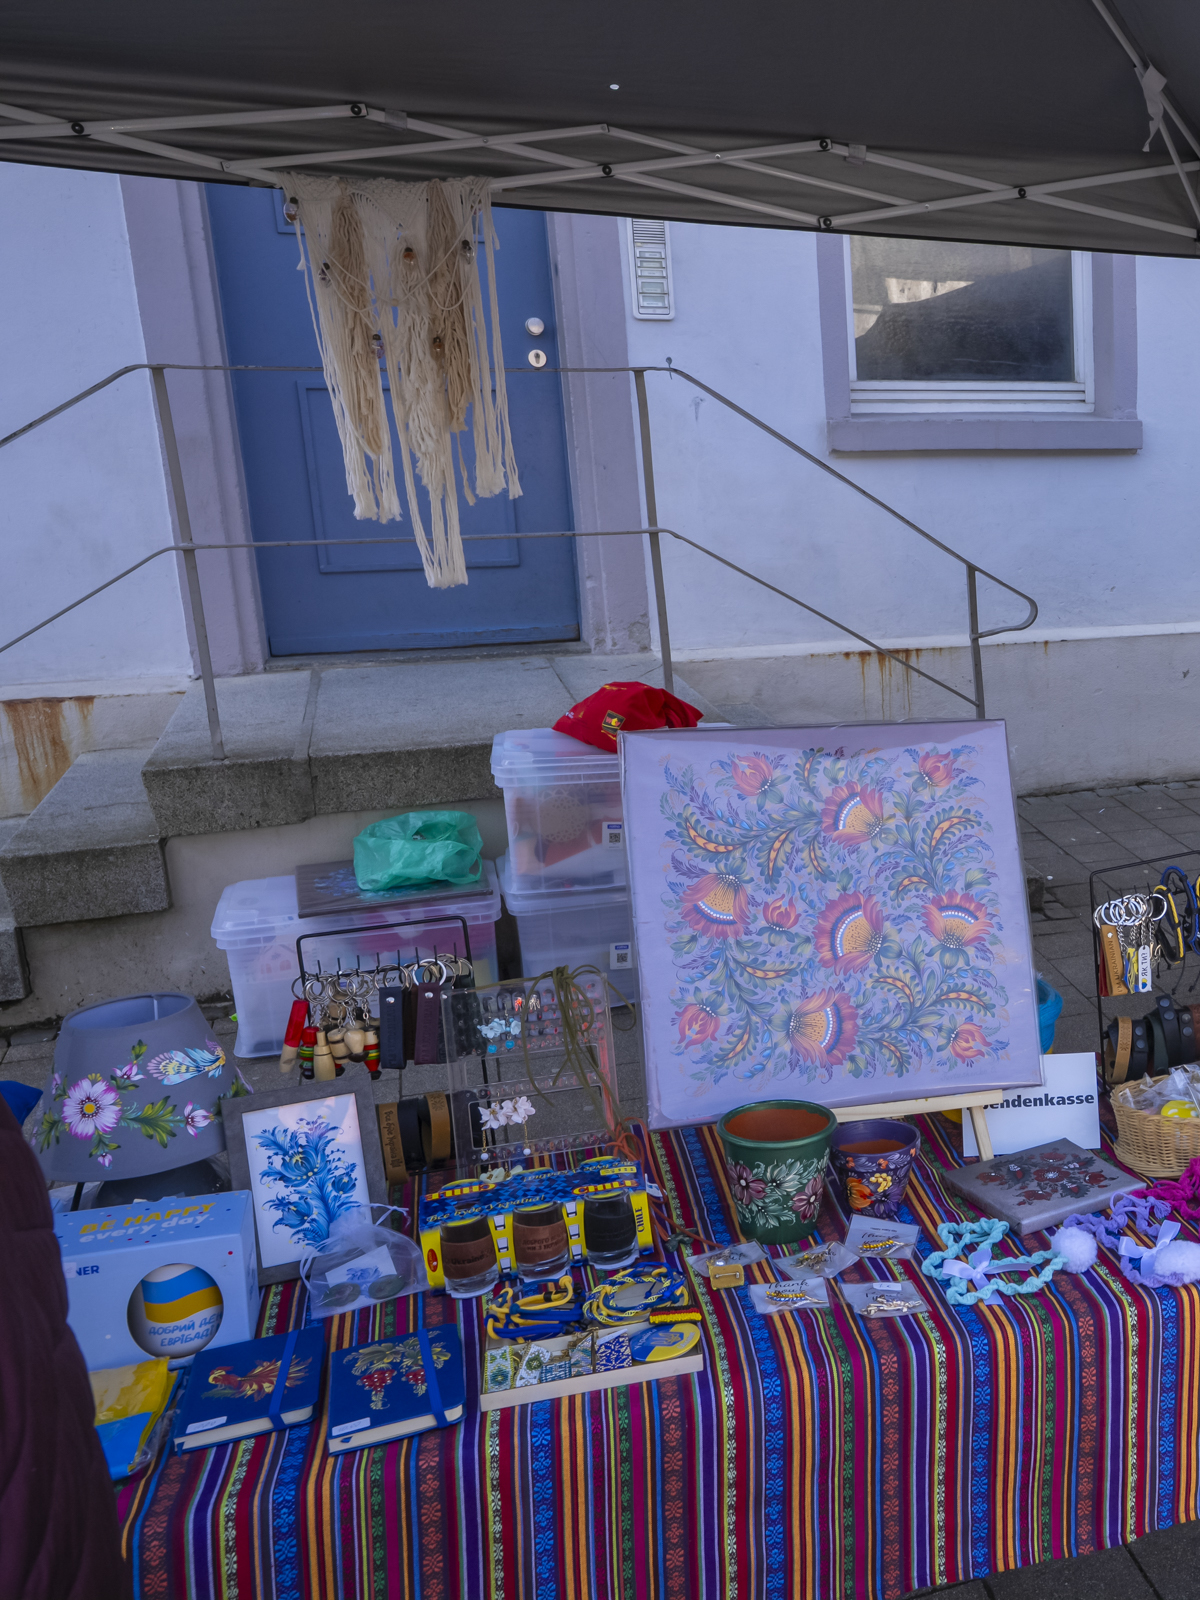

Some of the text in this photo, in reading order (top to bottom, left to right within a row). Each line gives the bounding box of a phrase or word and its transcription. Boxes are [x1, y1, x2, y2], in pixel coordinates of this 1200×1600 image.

[1107, 940, 1121, 981] UKRAINIAN
[1141, 964, 1149, 977] ЯК
[967, 1093, 1095, 1110] endenkasse
[571, 1179, 639, 1195] CHILE
[79, 1202, 217, 1235] BE HAPPY
[636, 1206, 644, 1233] CHILE
[79, 1222, 157, 1243] every
[148, 1319, 195, 1336] ДОБРИЙ
